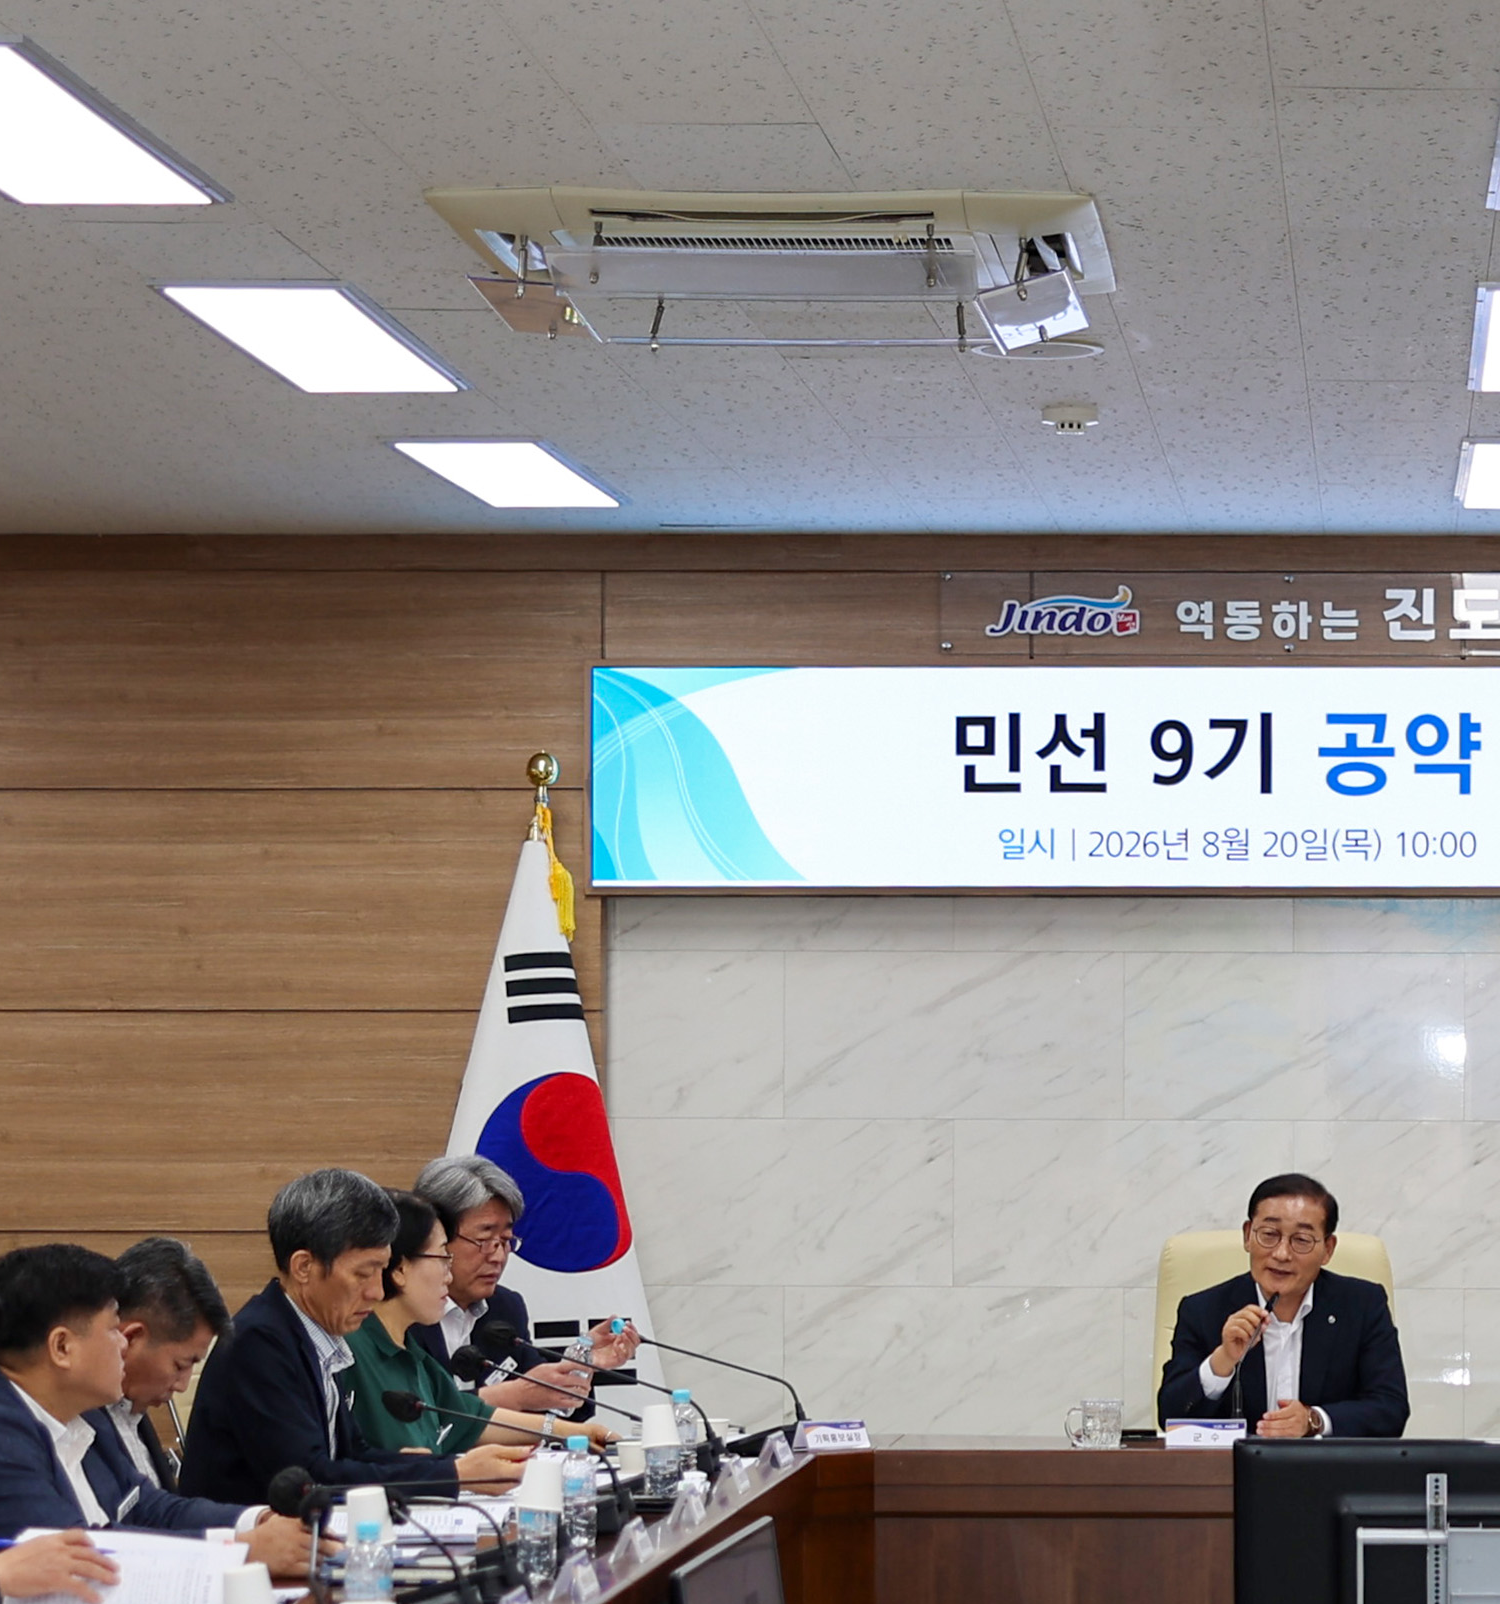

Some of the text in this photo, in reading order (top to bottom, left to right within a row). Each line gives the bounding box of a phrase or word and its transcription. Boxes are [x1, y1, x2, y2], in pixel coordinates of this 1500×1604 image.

[986, 600, 1112, 637] Jindo
[1176, 601, 1359, 640] 역동하는
[955, 712, 1107, 793] 민선
[1150, 712, 1273, 794] 9기
[1318, 712, 1482, 796] 공약
[999, 828, 1054, 860] 일시
[1089, 828, 1188, 860] 2026년
[1203, 828, 1249, 861] 8월
[1263, 829, 1381, 861] 20일(목)
[1397, 831, 1476, 858] 10:00
